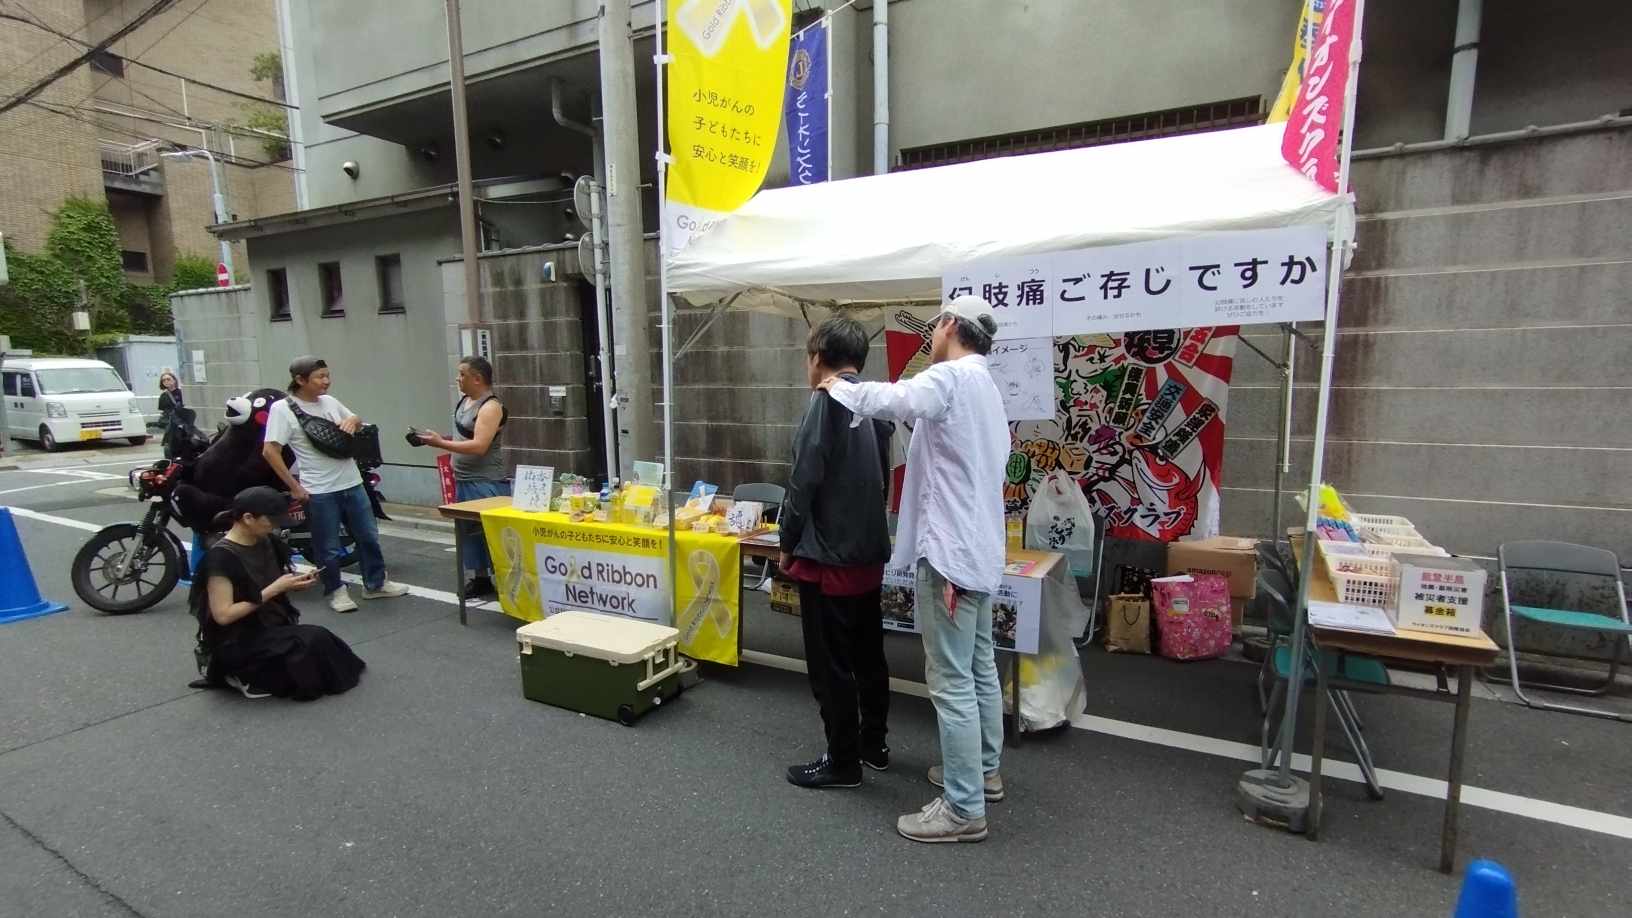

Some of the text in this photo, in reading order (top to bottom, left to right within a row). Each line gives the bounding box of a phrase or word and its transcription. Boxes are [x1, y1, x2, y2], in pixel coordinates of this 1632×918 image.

[692, 88, 755, 116] 小児がんの
[693, 115, 760, 146] 子どもたちに
[596, 561, 658, 589] Ribbon
[565, 584, 637, 614] Network
[1424, 605, 1456, 617] 募金箱
